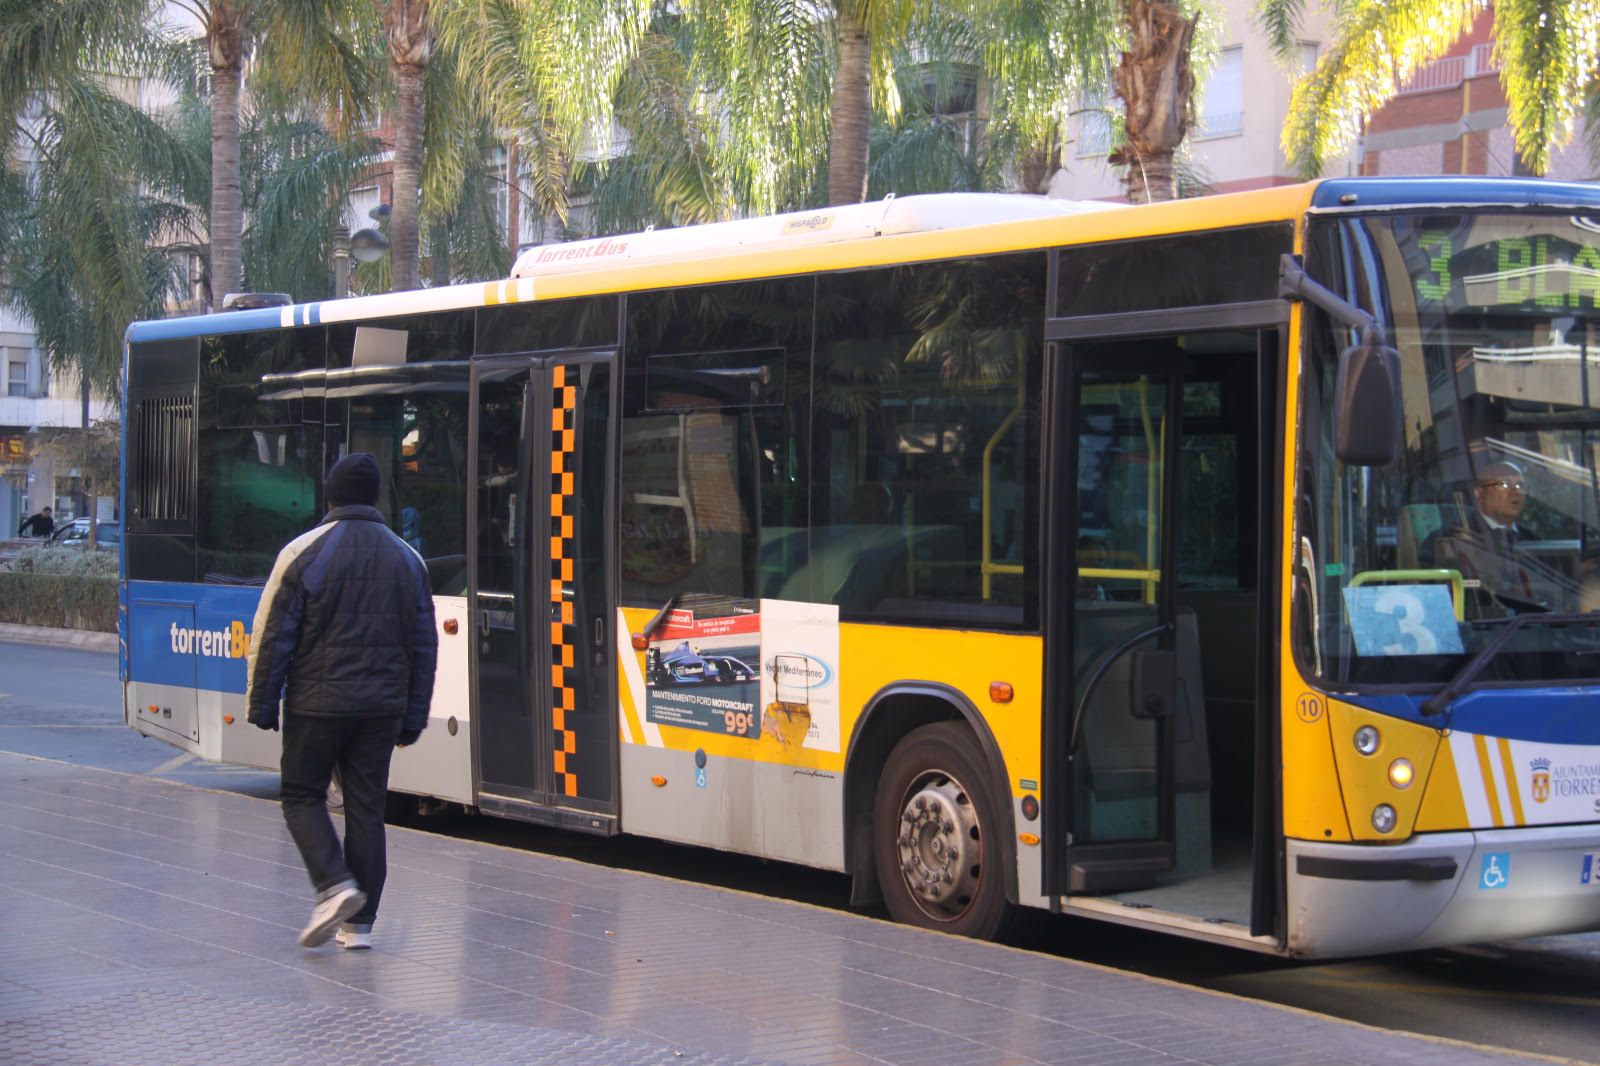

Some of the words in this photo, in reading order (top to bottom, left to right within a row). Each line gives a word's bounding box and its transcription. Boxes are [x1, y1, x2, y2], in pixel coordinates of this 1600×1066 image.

[1417, 230, 1451, 300] 3
[1374, 591, 1437, 655] 3
[697, 696, 712, 706] FORD
[712, 698, 754, 712] MOTORCRAFT
[1301, 700, 1319, 717] 10
[1552, 765, 1600, 779] AJUNTAM
[1552, 778, 1600, 797] TORRE
